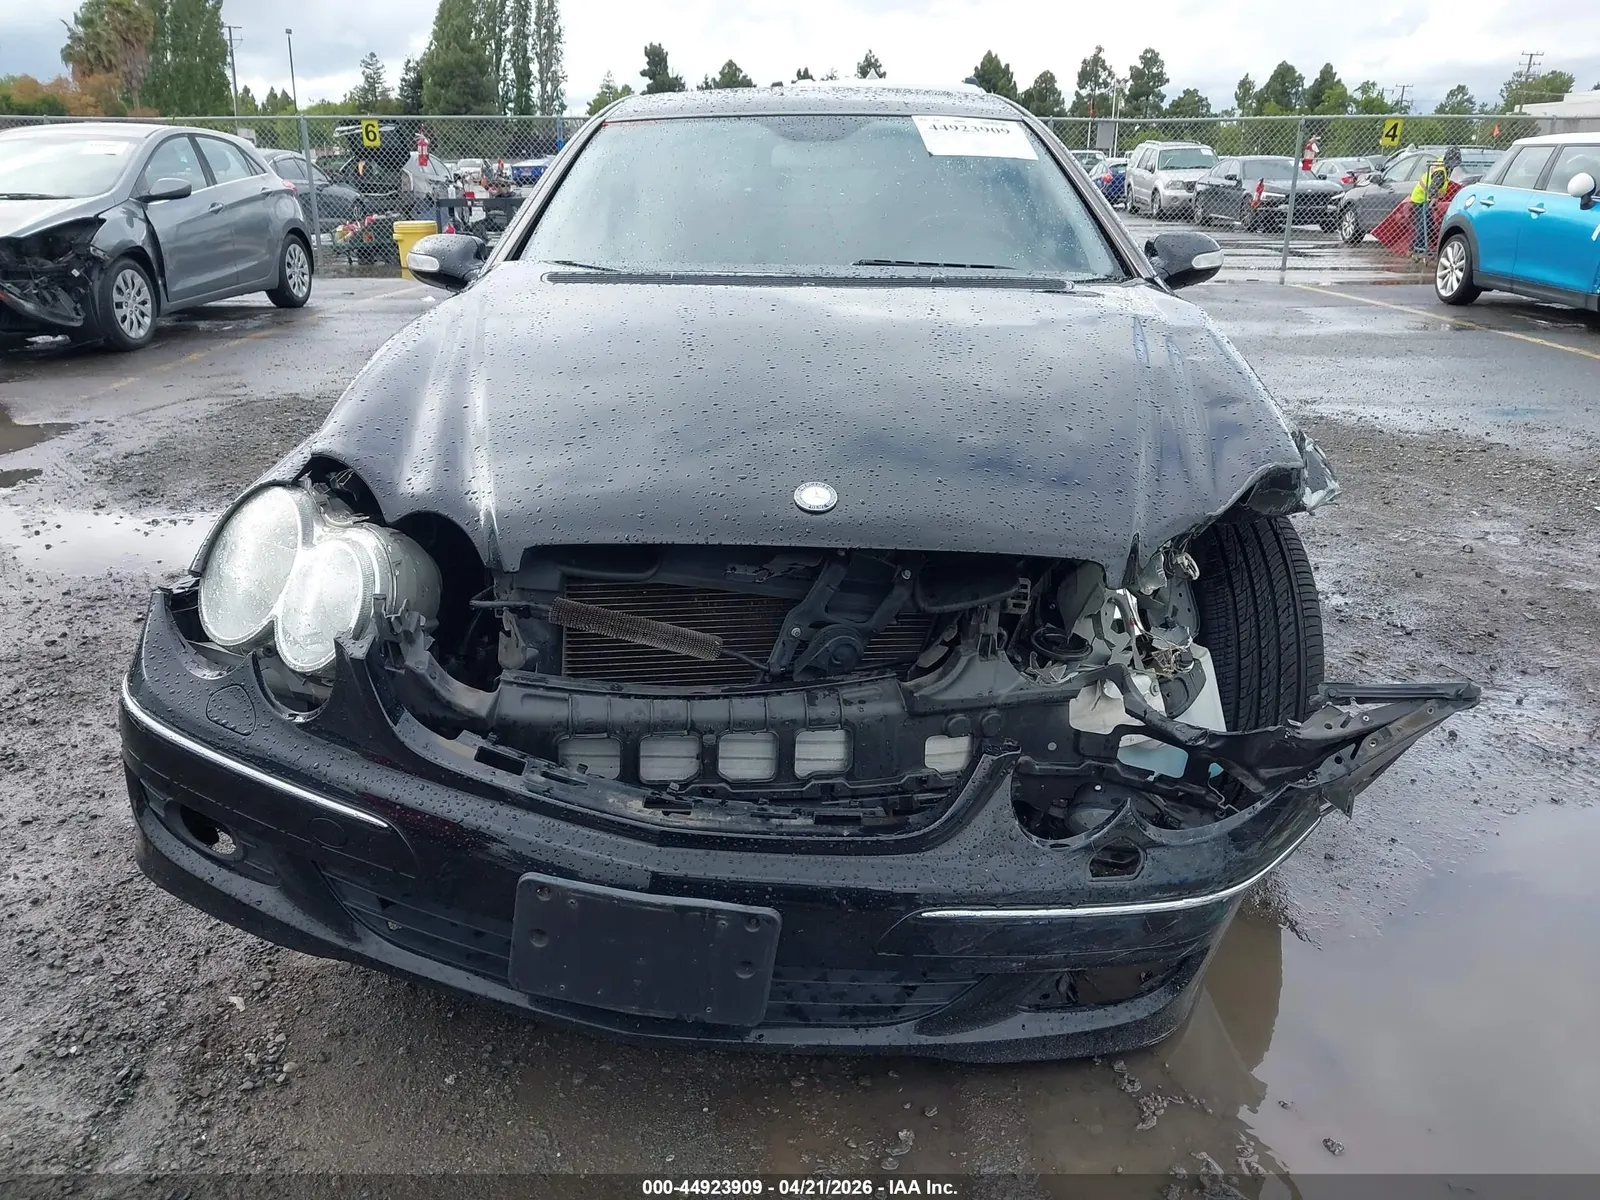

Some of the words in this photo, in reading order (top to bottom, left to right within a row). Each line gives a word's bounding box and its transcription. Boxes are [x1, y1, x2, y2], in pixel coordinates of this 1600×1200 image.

[365, 123, 377, 142] 6
[928, 123, 1010, 135] 44923909
[1385, 122, 1399, 142] 4
